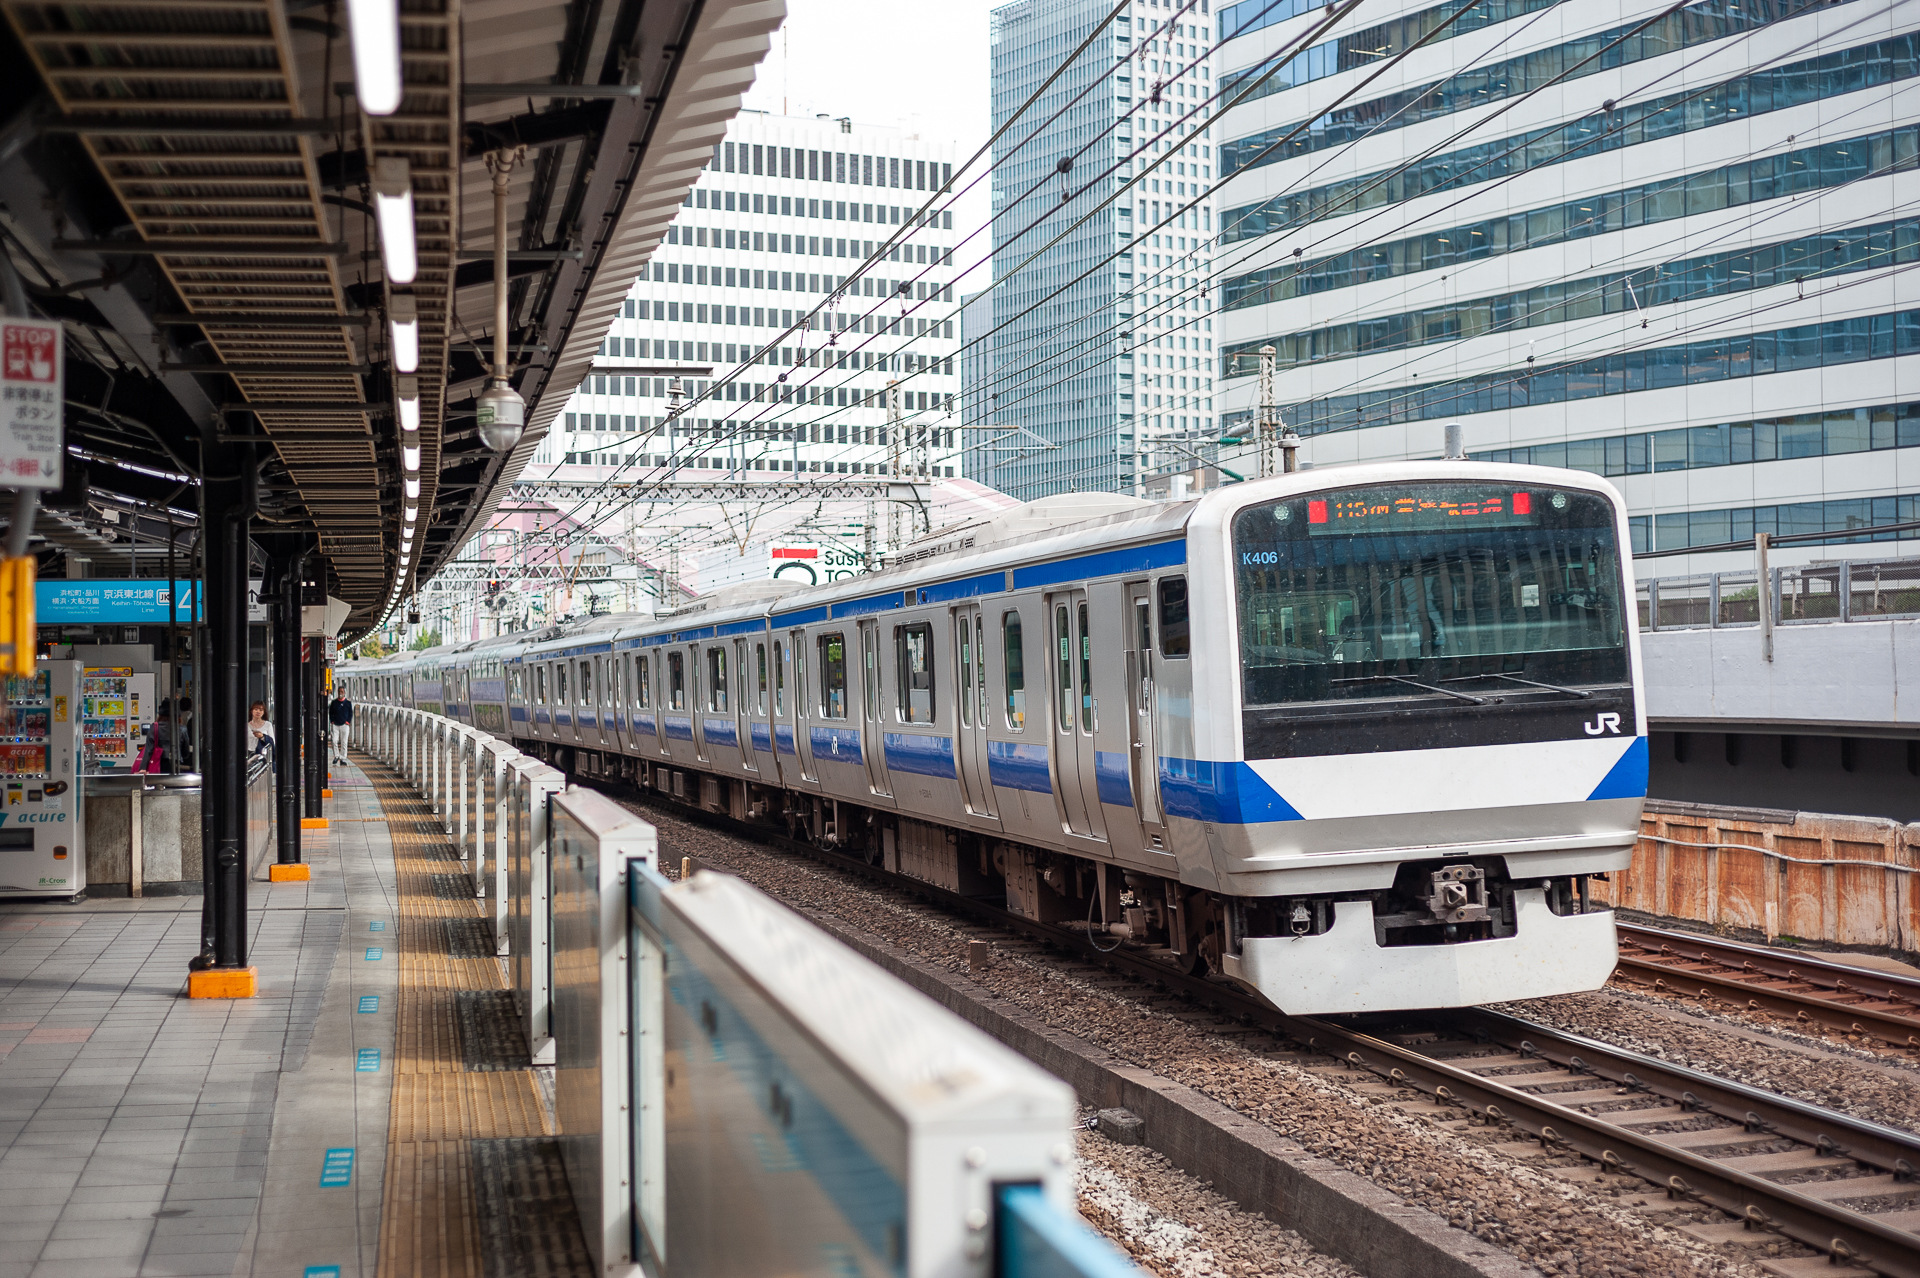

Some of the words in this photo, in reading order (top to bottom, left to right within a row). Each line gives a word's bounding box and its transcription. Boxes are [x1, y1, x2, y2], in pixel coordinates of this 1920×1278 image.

[7, 328, 52, 346] STOP
[3, 386, 54, 403] 非常停止
[16, 405, 55, 420] ボタン
[1243, 551, 1278, 565] K406
[104, 589, 154, 599] 京浜東北線
[1584, 712, 1621, 735] JR
[831, 735, 839, 755] JR
[18, 812, 67, 823] acure
